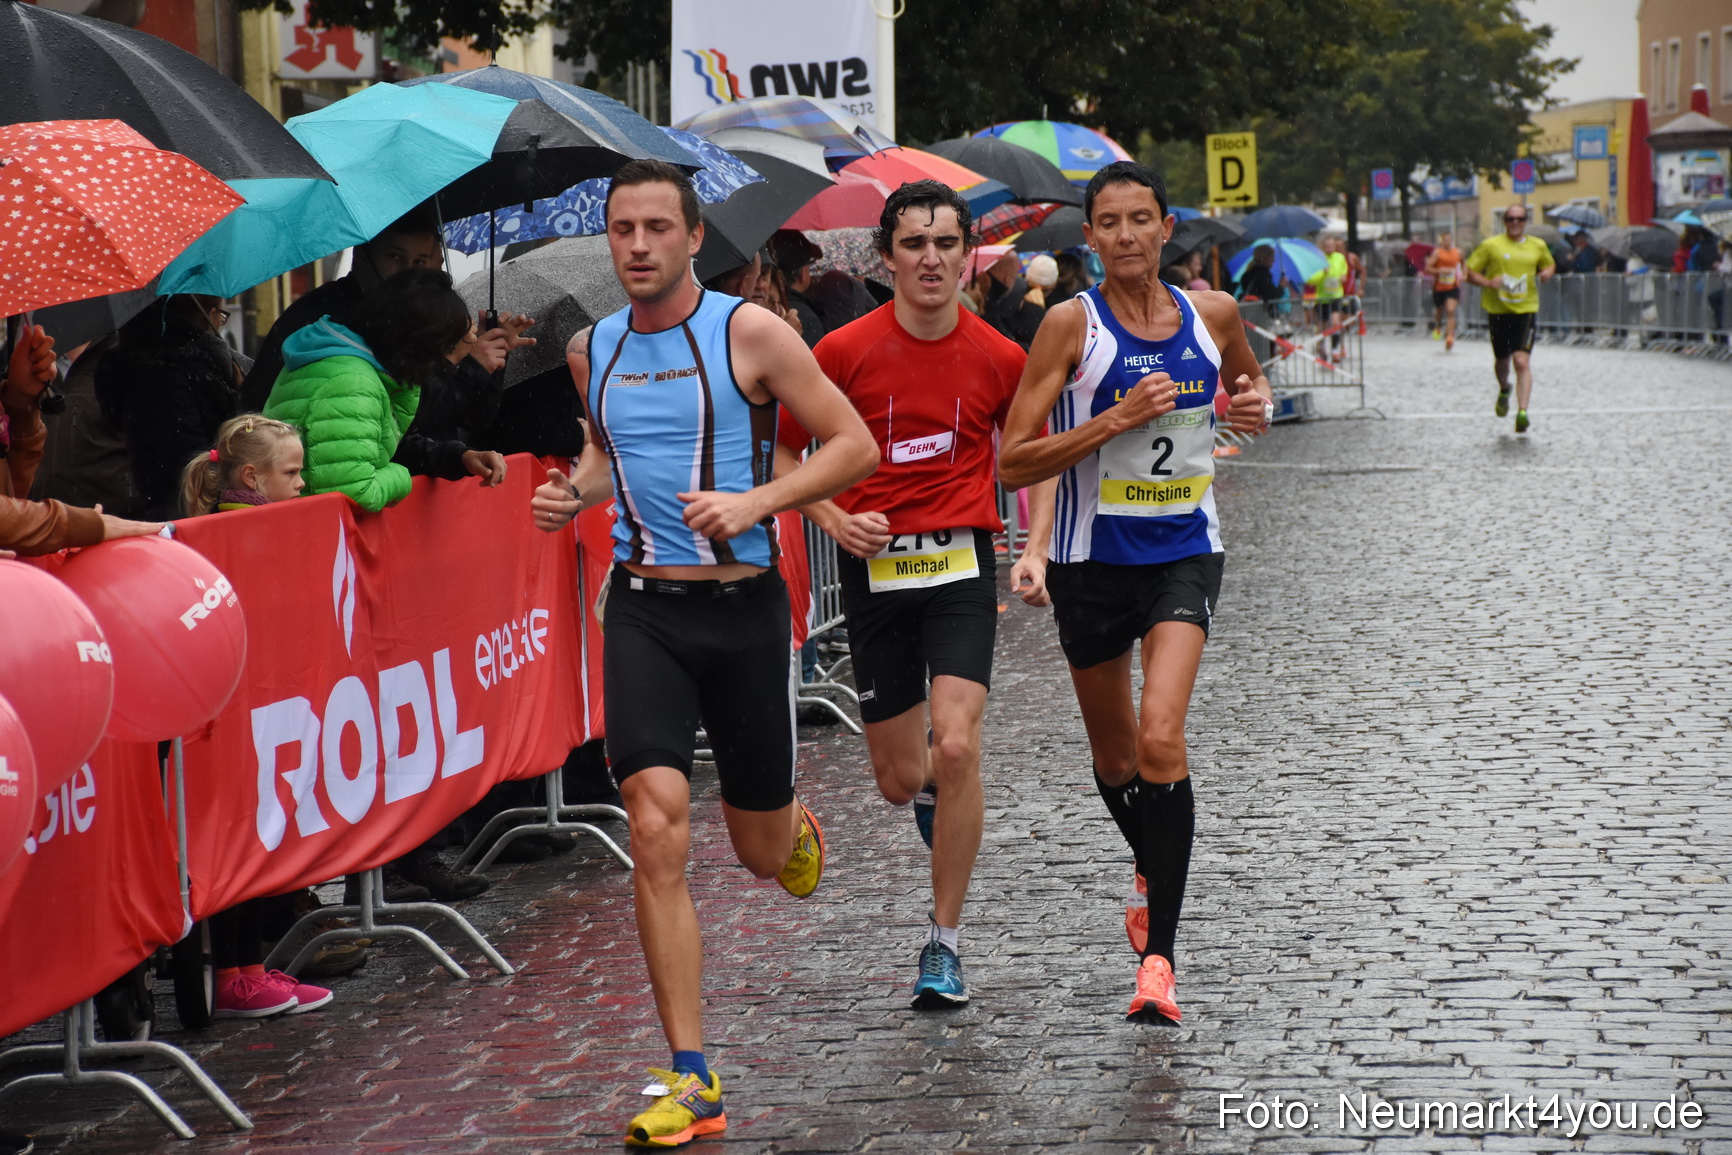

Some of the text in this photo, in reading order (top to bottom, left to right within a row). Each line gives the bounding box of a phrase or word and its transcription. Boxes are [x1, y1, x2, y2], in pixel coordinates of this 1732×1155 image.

[1213, 136, 1250, 151] Block
[1221, 155, 1244, 190] D
[1124, 353, 1164, 367] HEITEC
[1174, 380, 1205, 395] ELLE
[908, 441, 937, 455] DEHN
[1150, 436, 1174, 476] 2
[1103, 471, 1110, 480] A
[1125, 485, 1192, 502] Christine
[895, 556, 949, 576] Michael
[179, 574, 233, 631] ROD
[76, 641, 112, 665] RO
